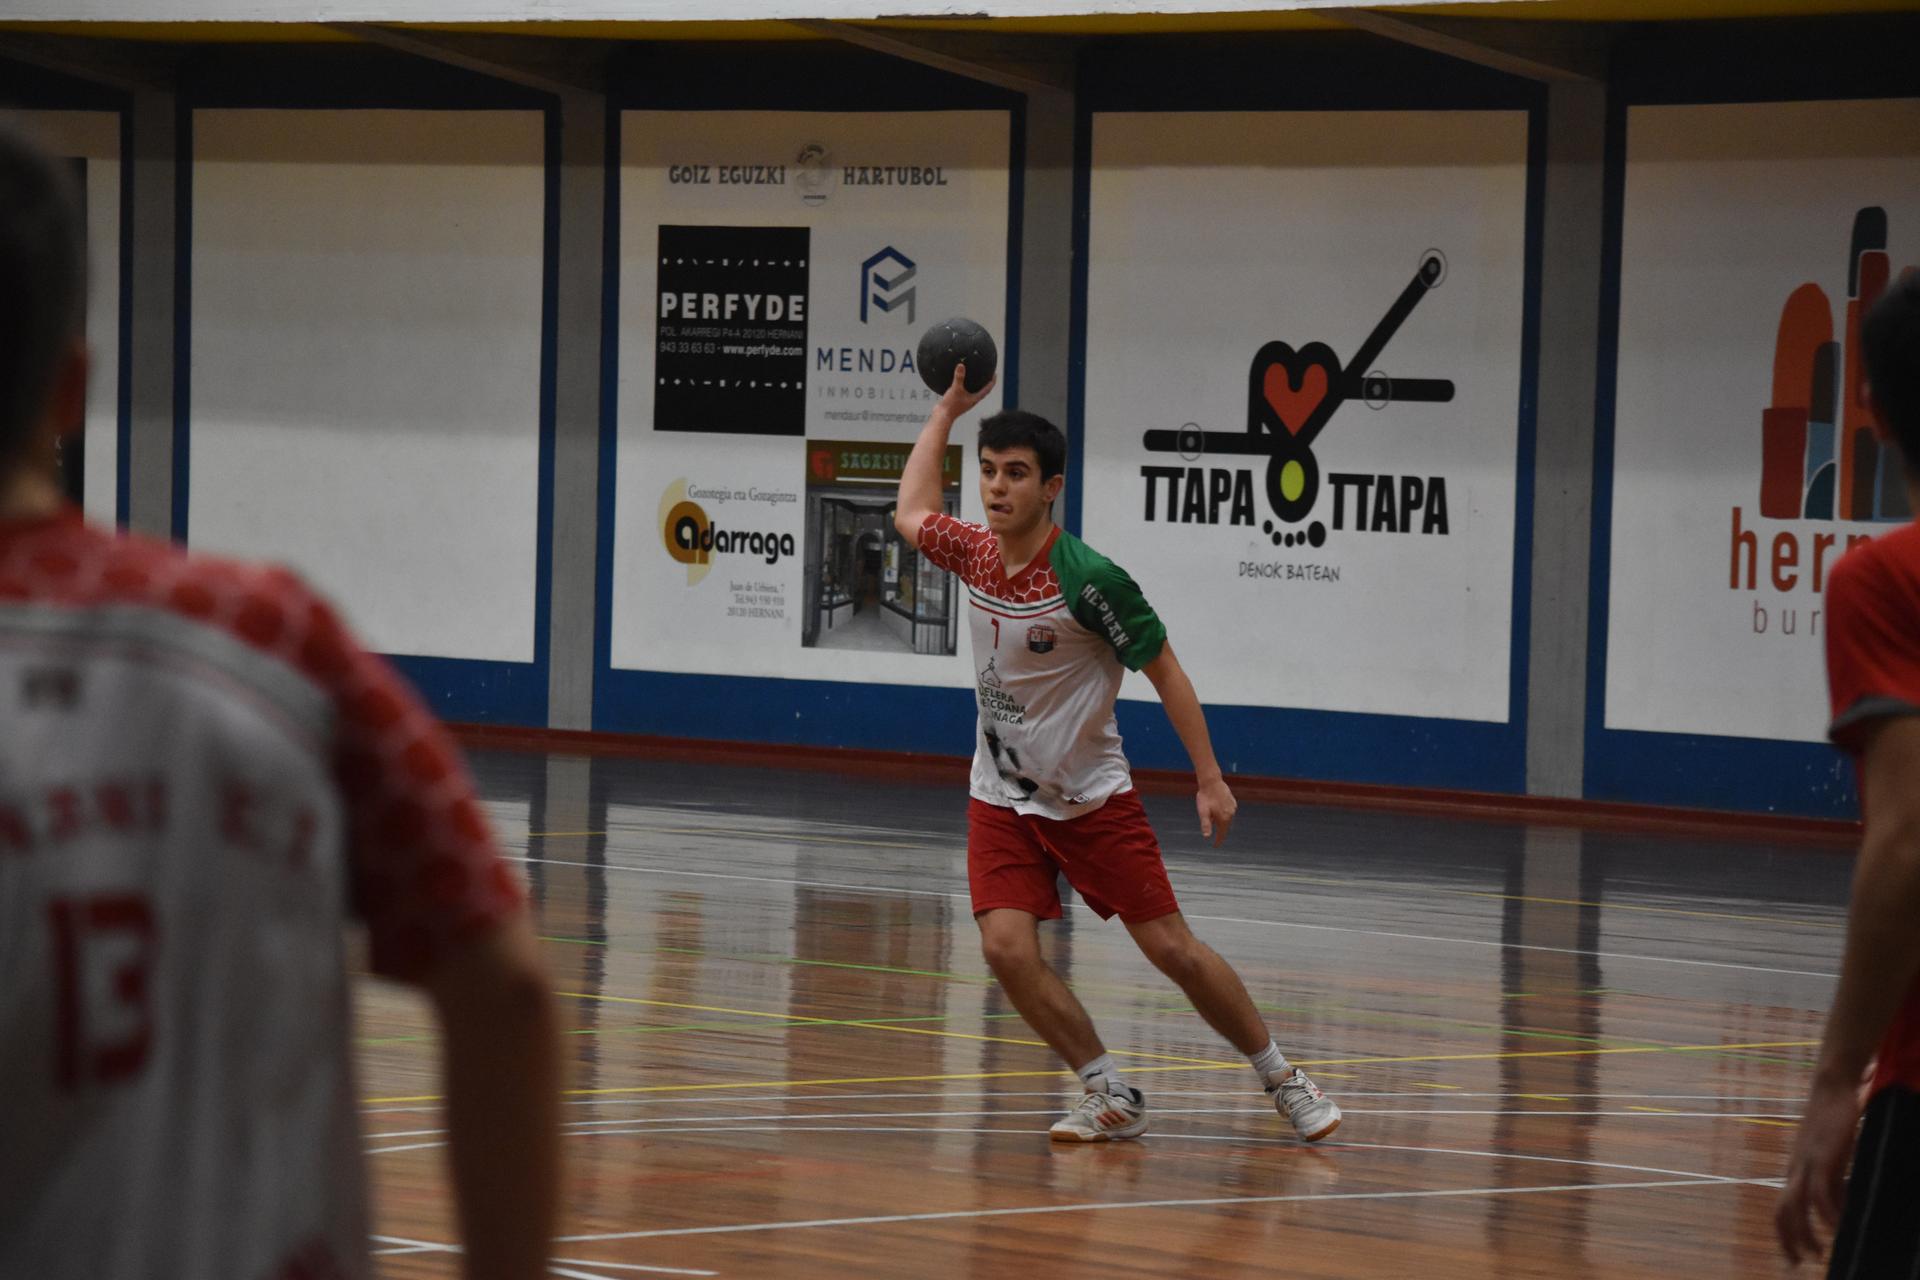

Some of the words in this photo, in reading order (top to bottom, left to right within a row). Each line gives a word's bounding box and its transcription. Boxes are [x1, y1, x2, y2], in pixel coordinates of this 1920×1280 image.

[669, 165, 711, 184] GOIZ
[719, 165, 786, 185] EGUZKI
[661, 292, 804, 321] PERFYDE
[723, 344, 803, 358] www.perfyde.com
[817, 347, 915, 373] MENDA
[818, 386, 941, 401] INMOBILIAR
[1141, 466, 1255, 526] TTAPA
[1328, 473, 1449, 535] TTAPA
[1730, 507, 1872, 593] her
[1239, 561, 1283, 579] DENOK
[1286, 563, 1341, 582] BATEAN
[1753, 600, 1821, 635] bur
